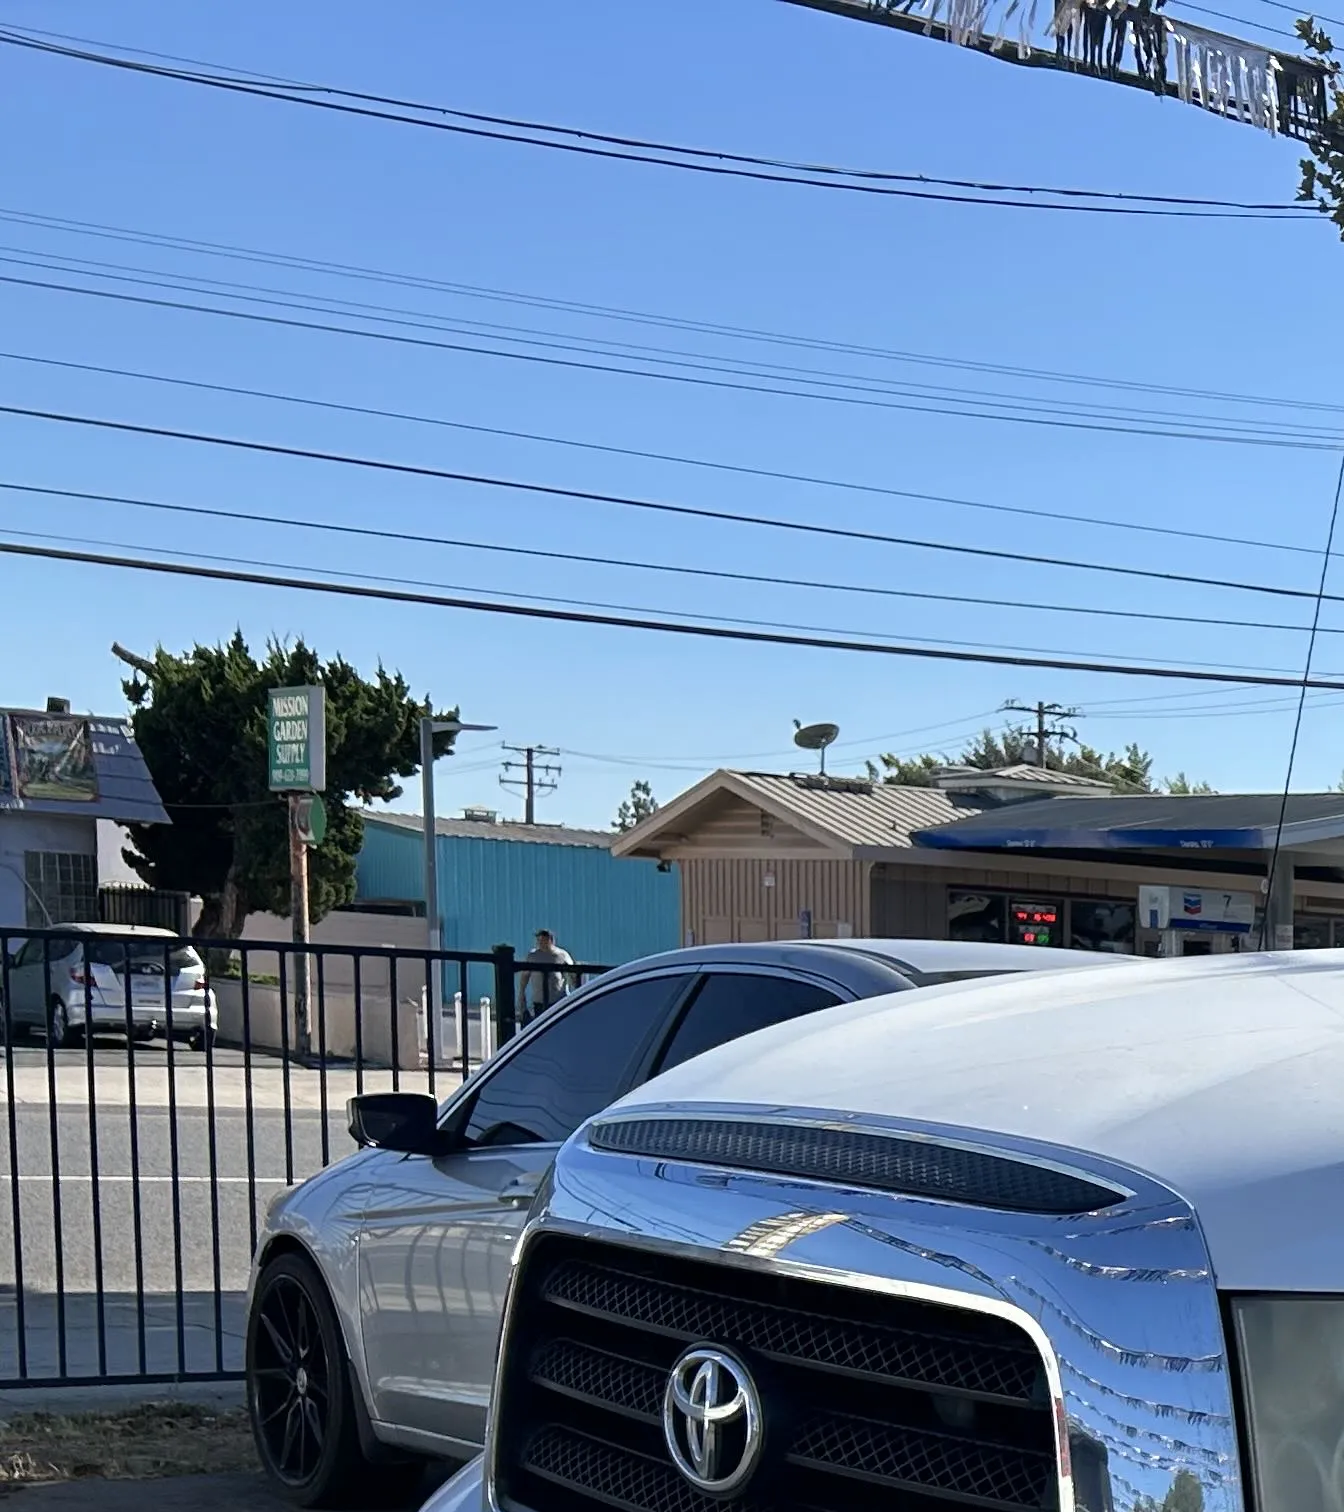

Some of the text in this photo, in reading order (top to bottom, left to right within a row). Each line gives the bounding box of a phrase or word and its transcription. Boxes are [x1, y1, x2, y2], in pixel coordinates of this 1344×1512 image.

[273, 695, 308, 717] MISSION
[273, 720, 308, 741] GARDEN
[276, 743, 305, 764] SUPPLY
